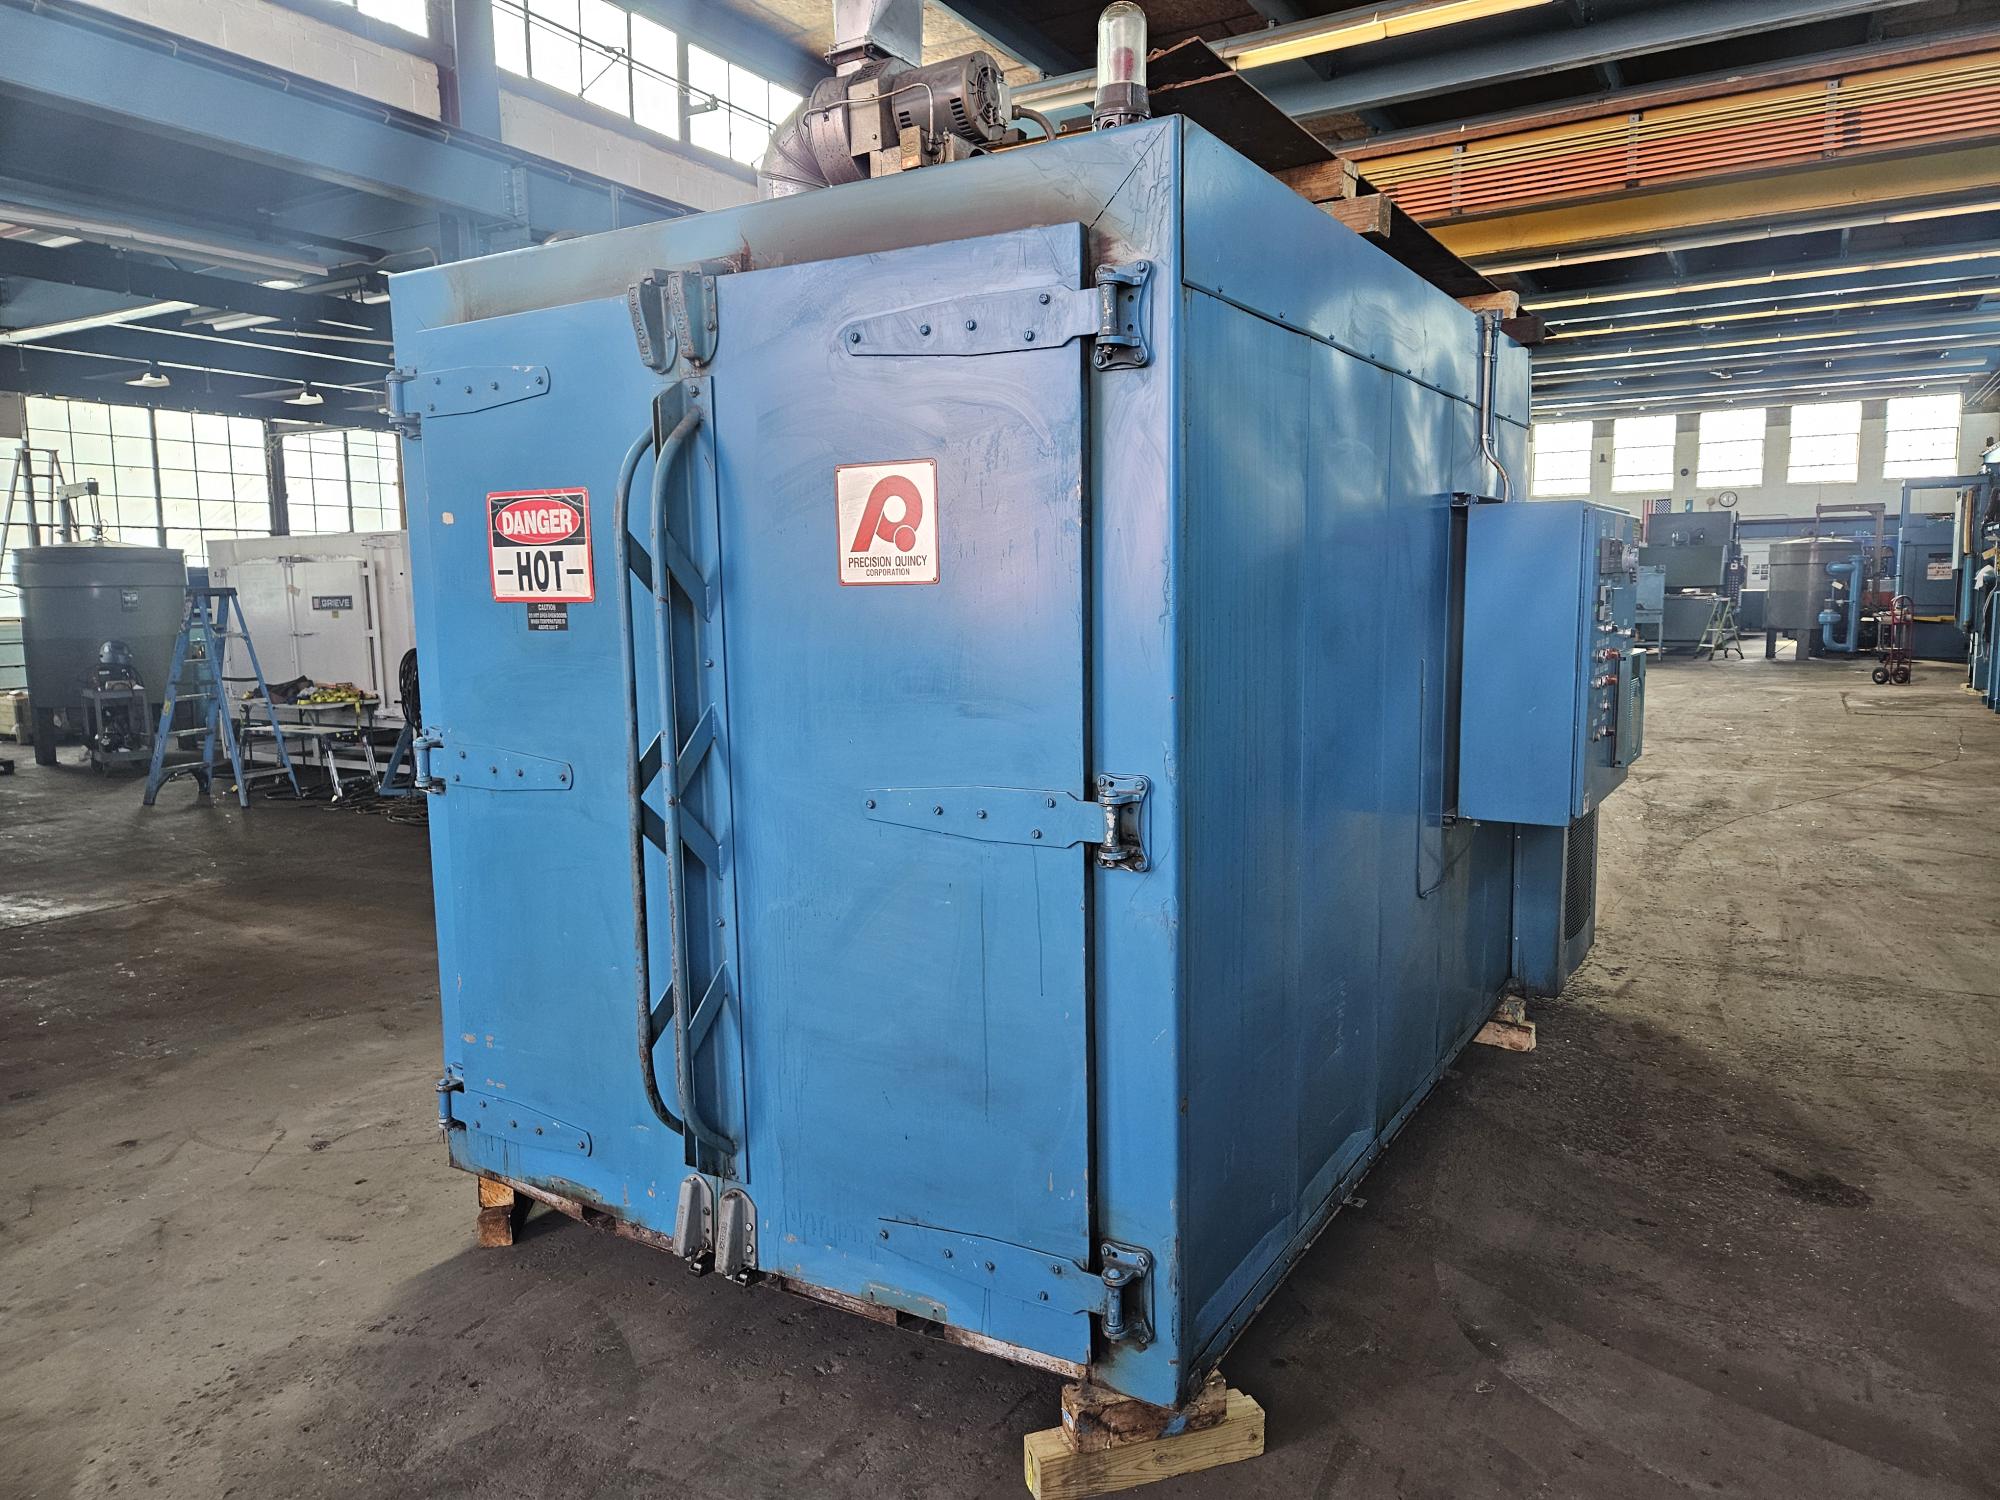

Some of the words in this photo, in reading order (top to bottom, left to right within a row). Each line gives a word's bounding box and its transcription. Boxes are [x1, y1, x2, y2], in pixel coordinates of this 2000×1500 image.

[502, 508, 573, 535] DANGER
[848, 556, 892, 568] PRECISION
[895, 554, 928, 567] QUINCY
[866, 567, 910, 577] CORPORATION
